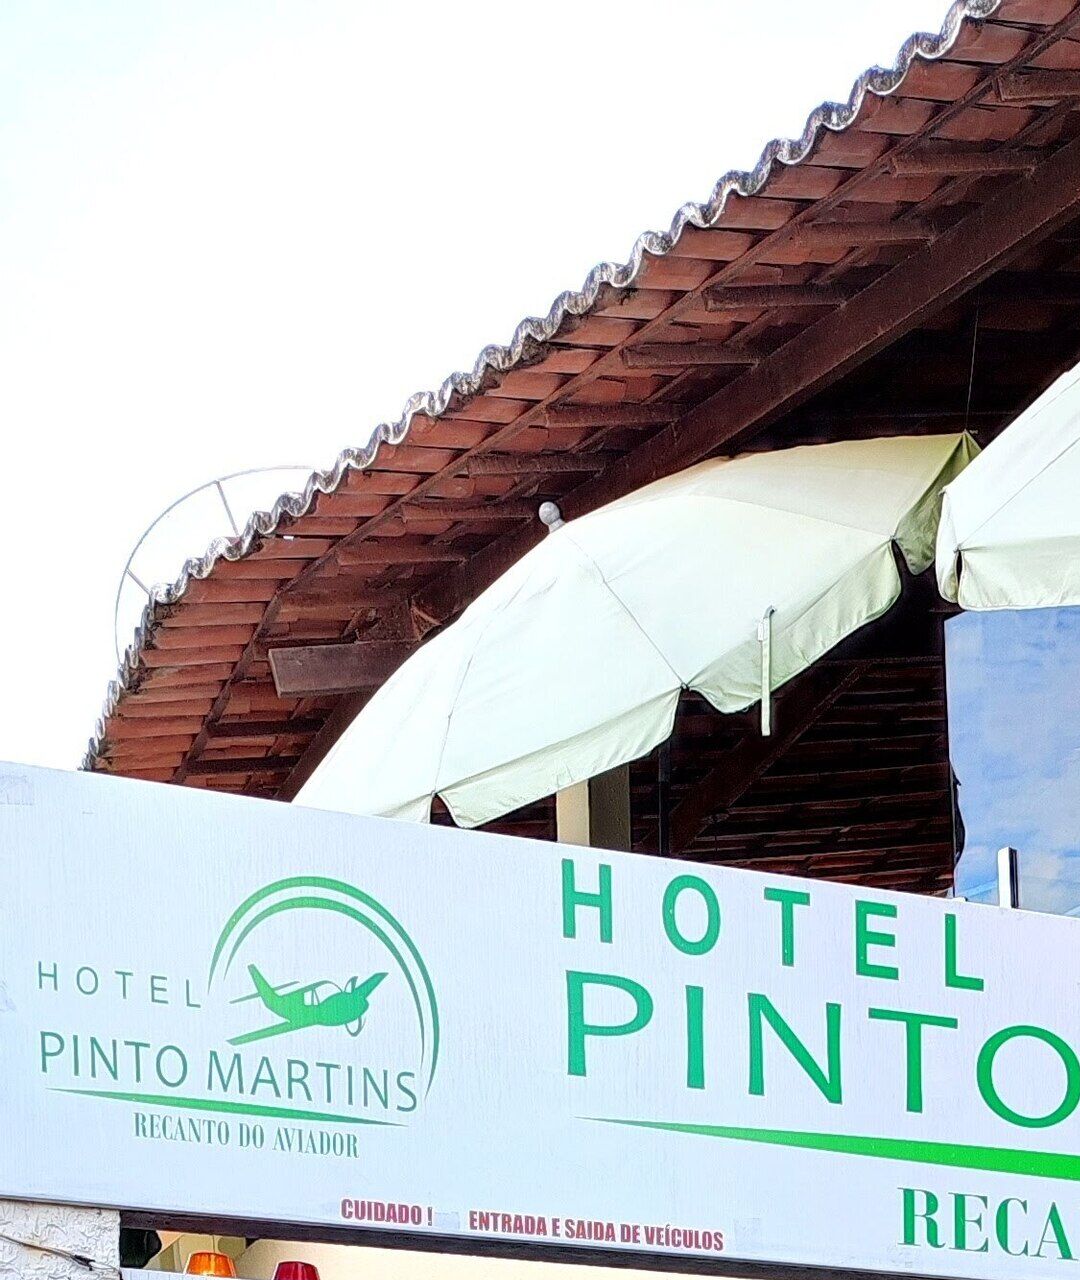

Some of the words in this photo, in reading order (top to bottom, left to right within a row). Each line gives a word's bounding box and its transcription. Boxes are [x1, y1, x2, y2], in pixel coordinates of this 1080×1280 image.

[562, 858, 984, 992] HOTEL
[38, 961, 201, 1008] HOTEL
[40, 1030, 188, 1088] PINTO
[207, 1049, 418, 1113] MARTINS
[134, 1112, 230, 1148] RECANTO
[239, 1123, 265, 1149] DO
[273, 1127, 360, 1159] AVIADOR
[340, 1198, 422, 1226] CUIDADO
[469, 1210, 547, 1237] ENTRADA
[551, 1218, 561, 1238] E
[564, 1219, 617, 1243] SAIDA
[620, 1226, 641, 1245] DE
[645, 1223, 724, 1251] VEÍCULOS
